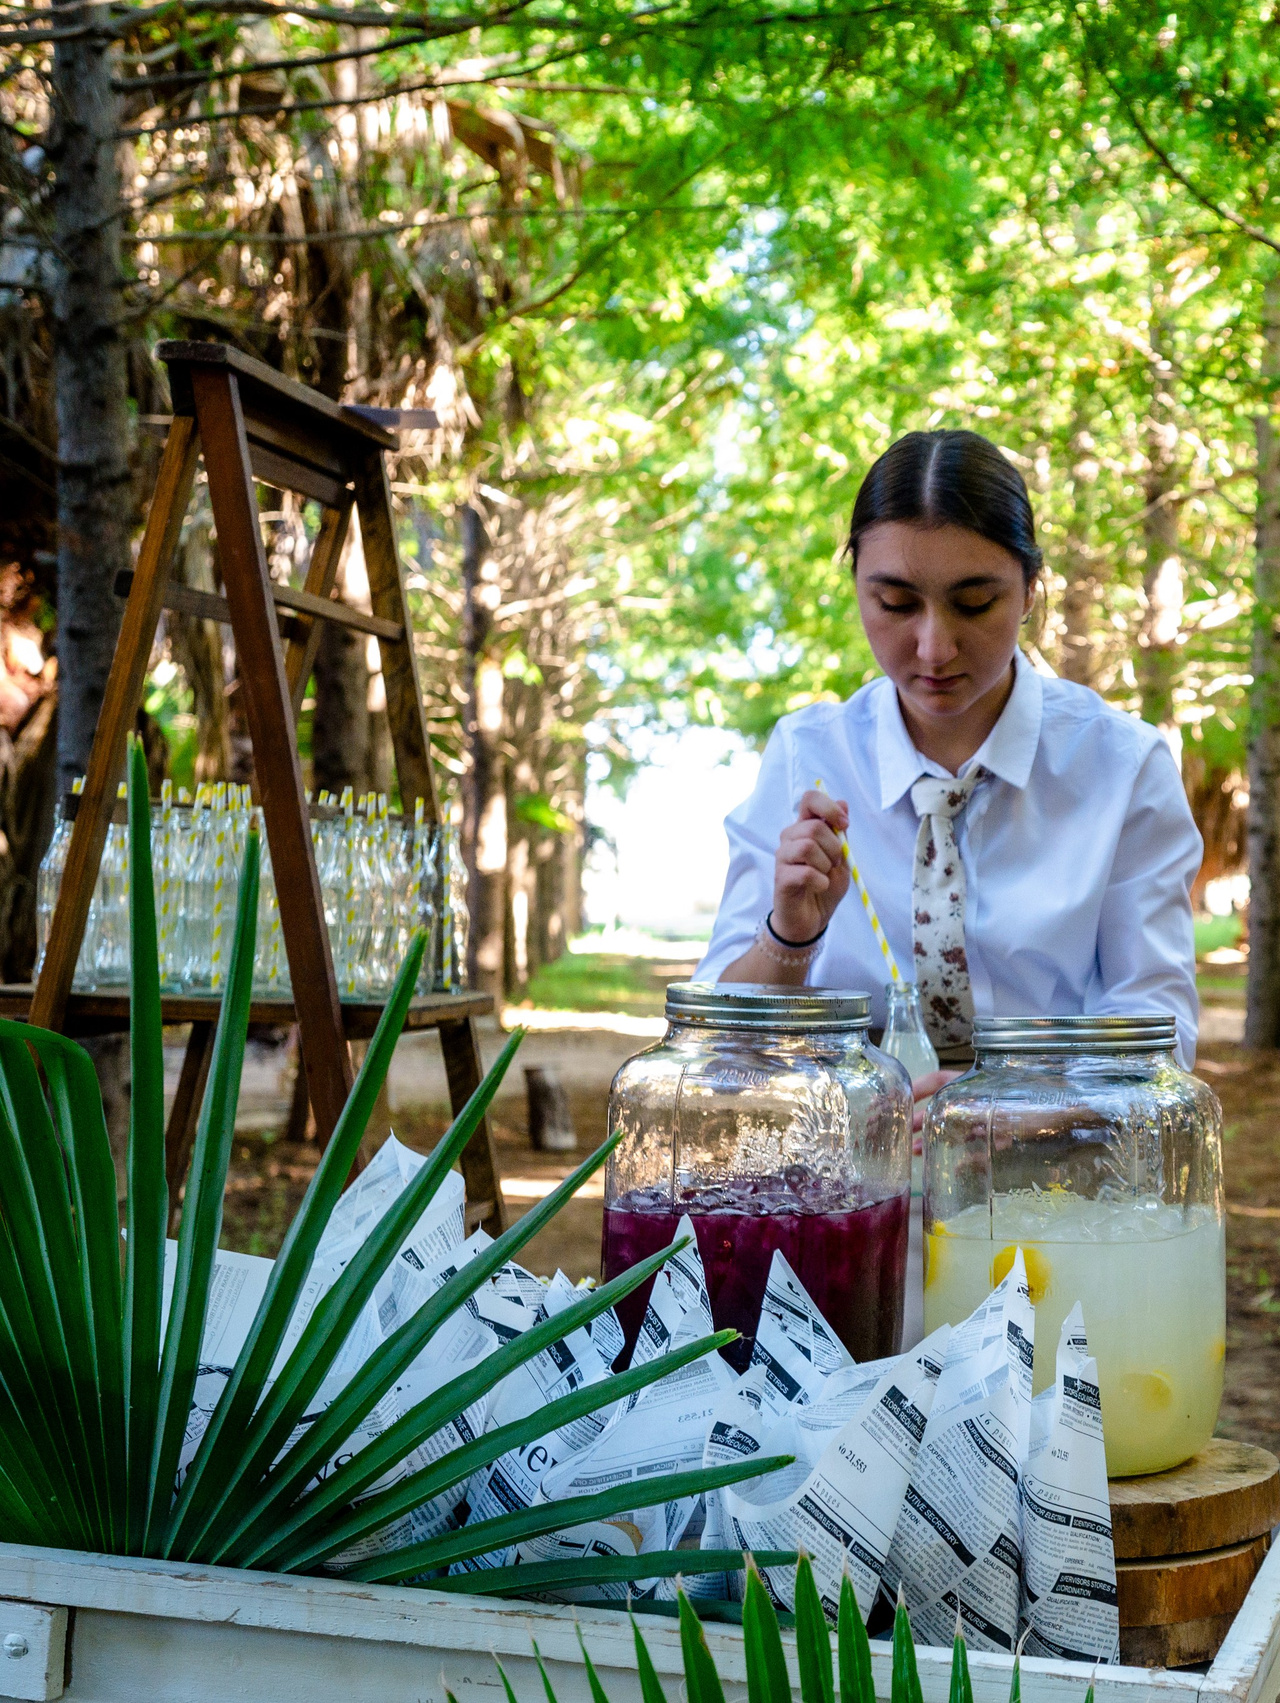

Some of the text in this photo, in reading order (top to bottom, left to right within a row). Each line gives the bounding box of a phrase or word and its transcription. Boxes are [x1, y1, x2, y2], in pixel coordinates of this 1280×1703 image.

[899, 1411, 924, 1440] REQUIRED
[965, 1419, 998, 1459] SUPERVISOR
[845, 1450, 867, 1474] 21,553
[926, 1443, 959, 1481] EXPERIENCE:
[819, 1487, 841, 1509] pages
[924, 1508, 959, 1546] SECRETARY
[935, 1601, 976, 1637] QUALIFITION:
[965, 1611, 988, 1631] NURSE
